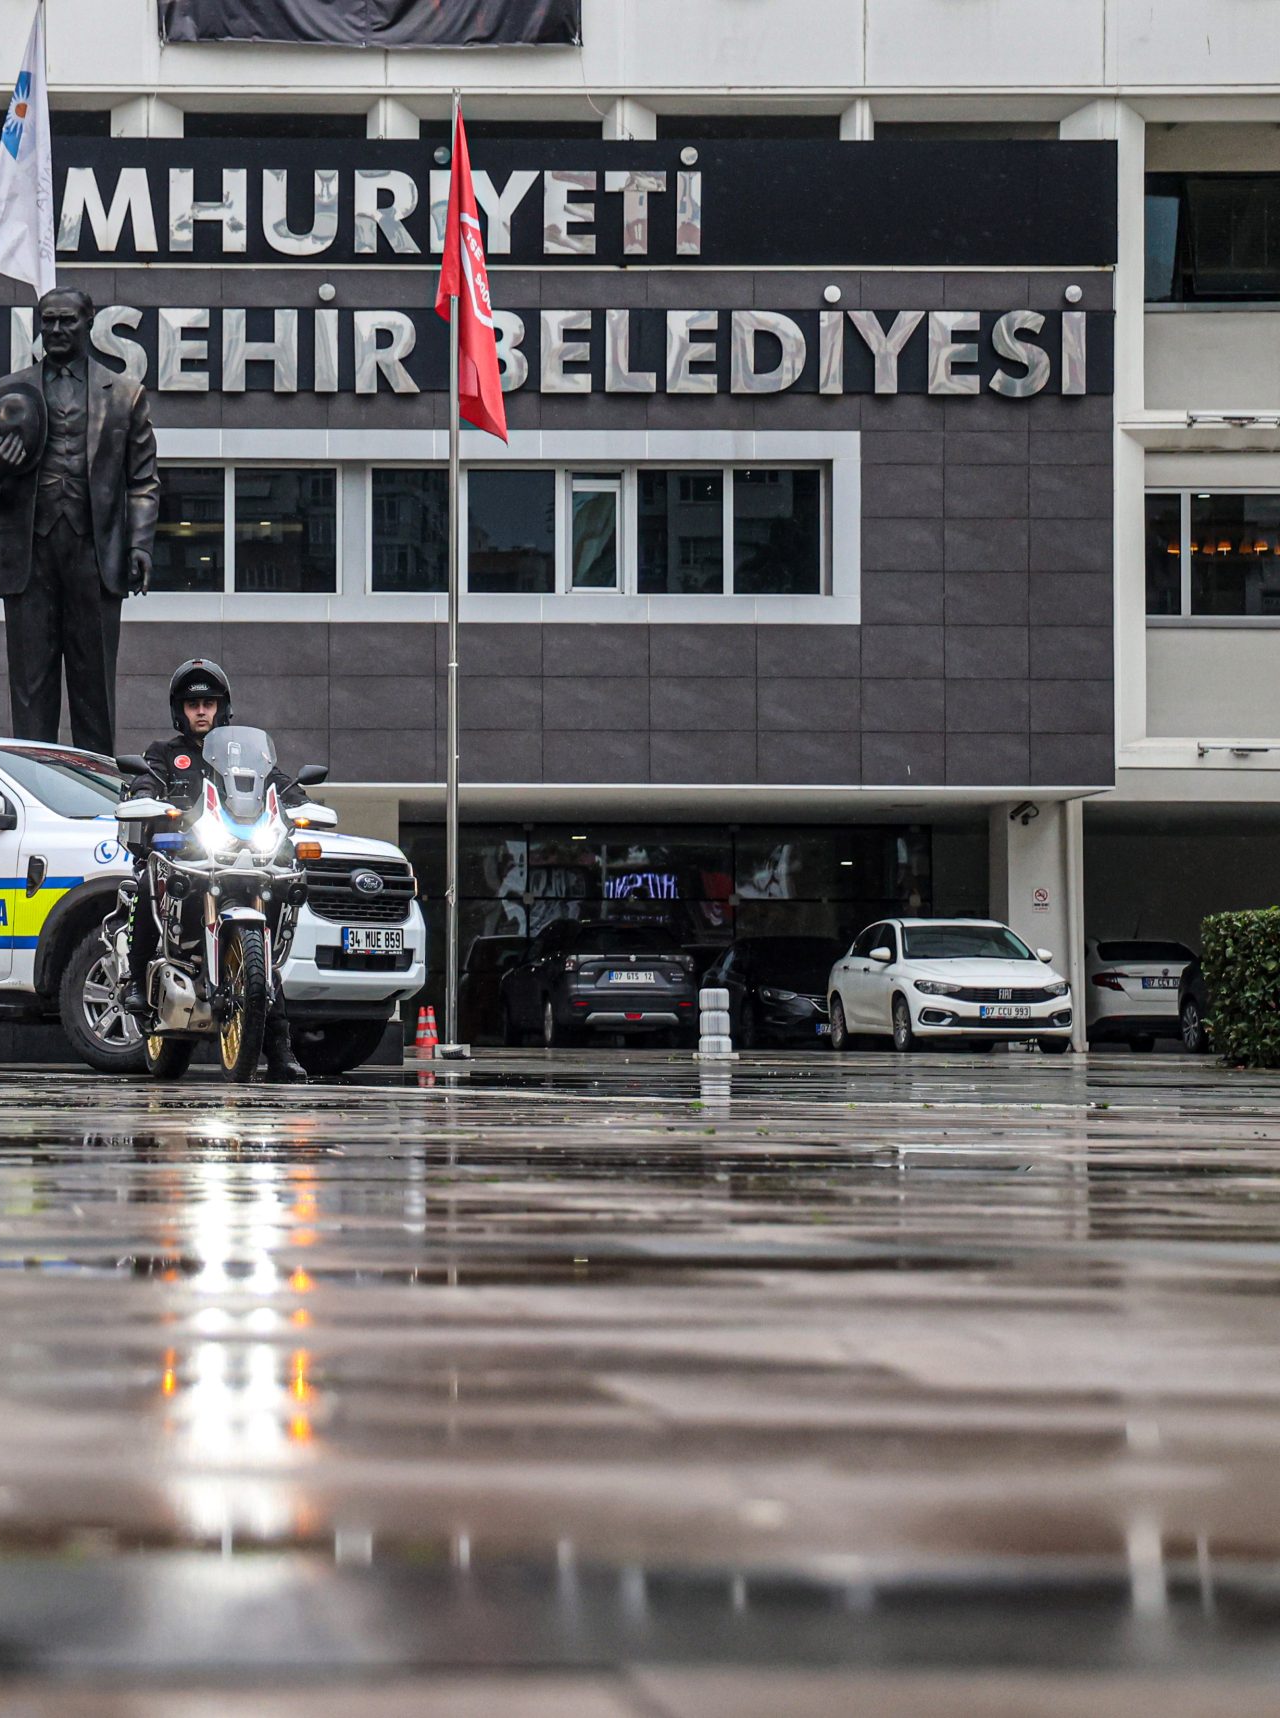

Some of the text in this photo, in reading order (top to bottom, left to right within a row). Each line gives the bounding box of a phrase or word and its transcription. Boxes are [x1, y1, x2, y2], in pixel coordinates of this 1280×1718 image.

[350, 931, 400, 948] 34 MUE 859
[614, 972, 622, 980] 07
[999, 989, 1012, 1000] FIAT
